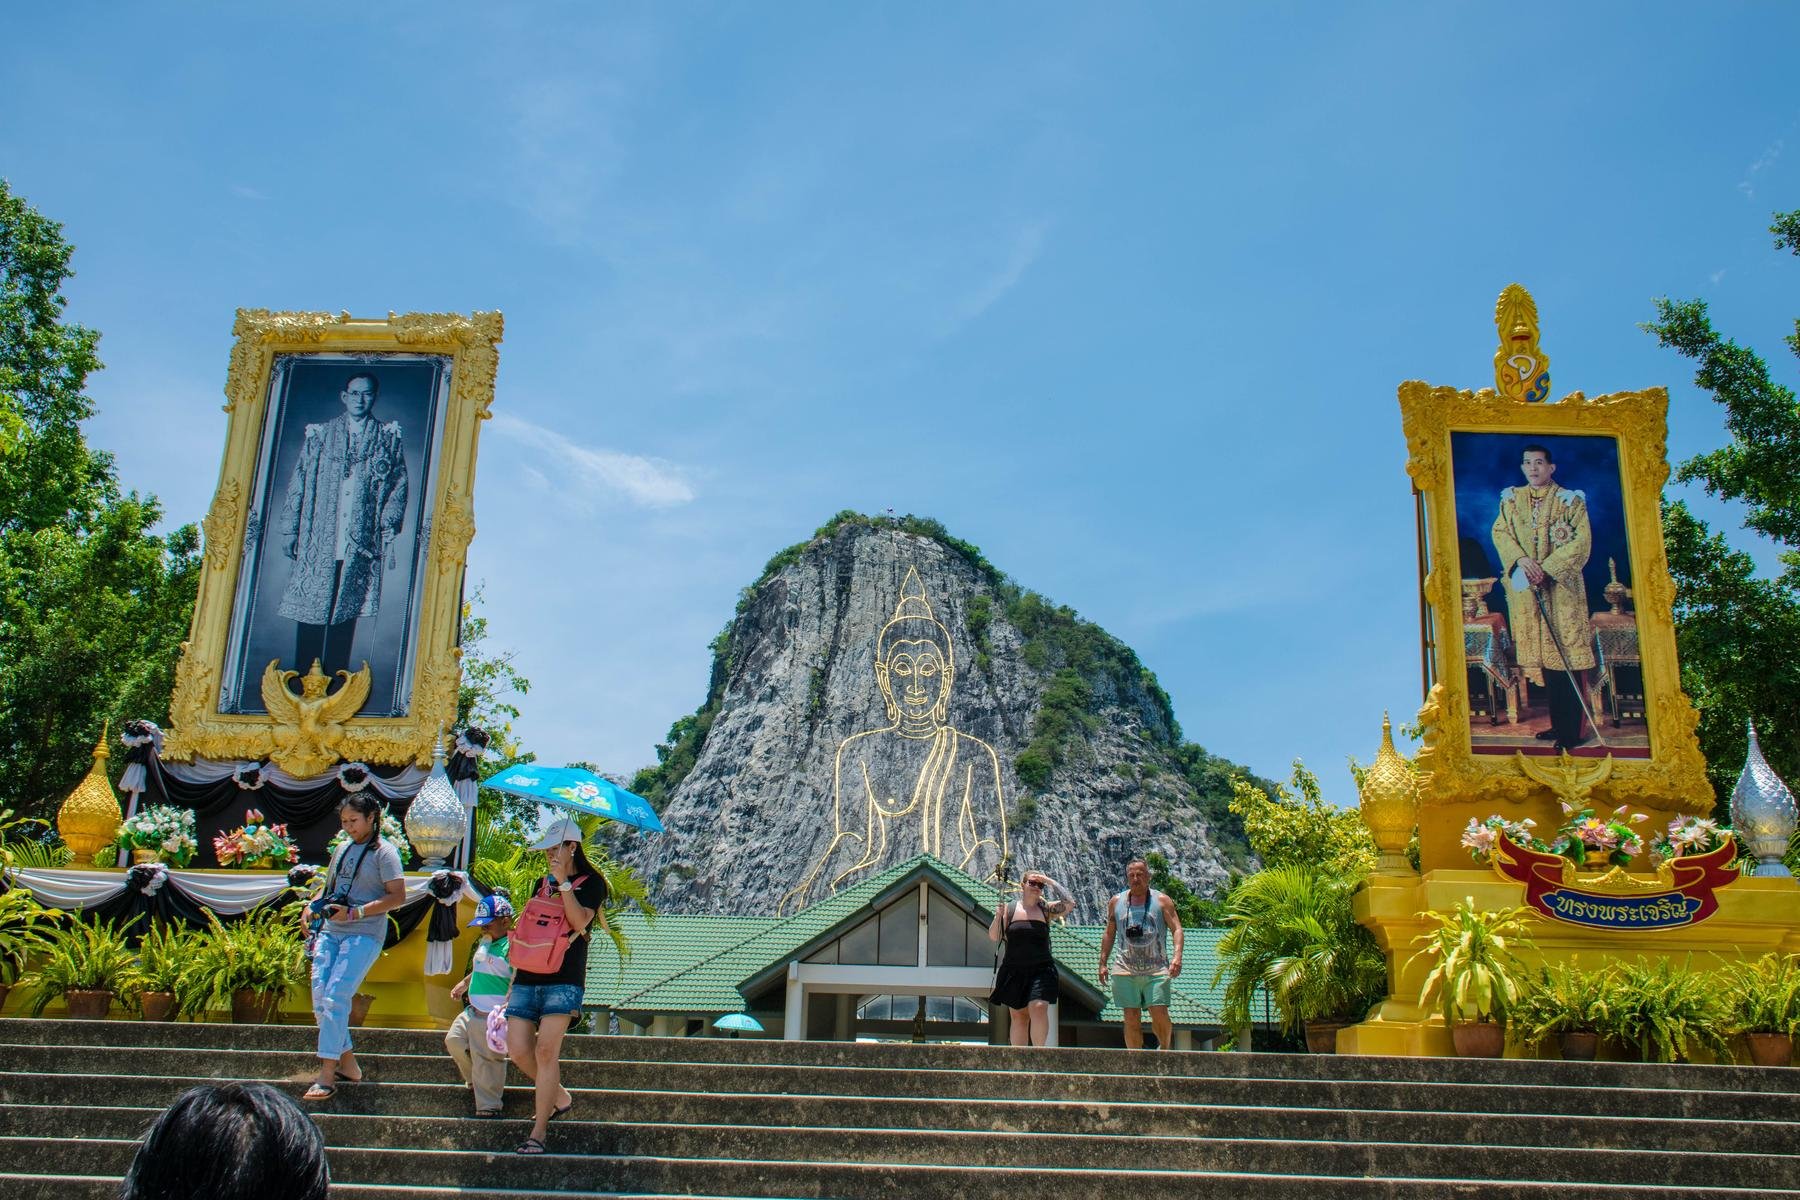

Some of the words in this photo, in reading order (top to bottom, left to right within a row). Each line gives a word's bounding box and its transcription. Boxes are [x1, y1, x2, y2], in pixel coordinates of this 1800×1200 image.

[1556, 897, 1688, 921] ทรงพระเจริญ
